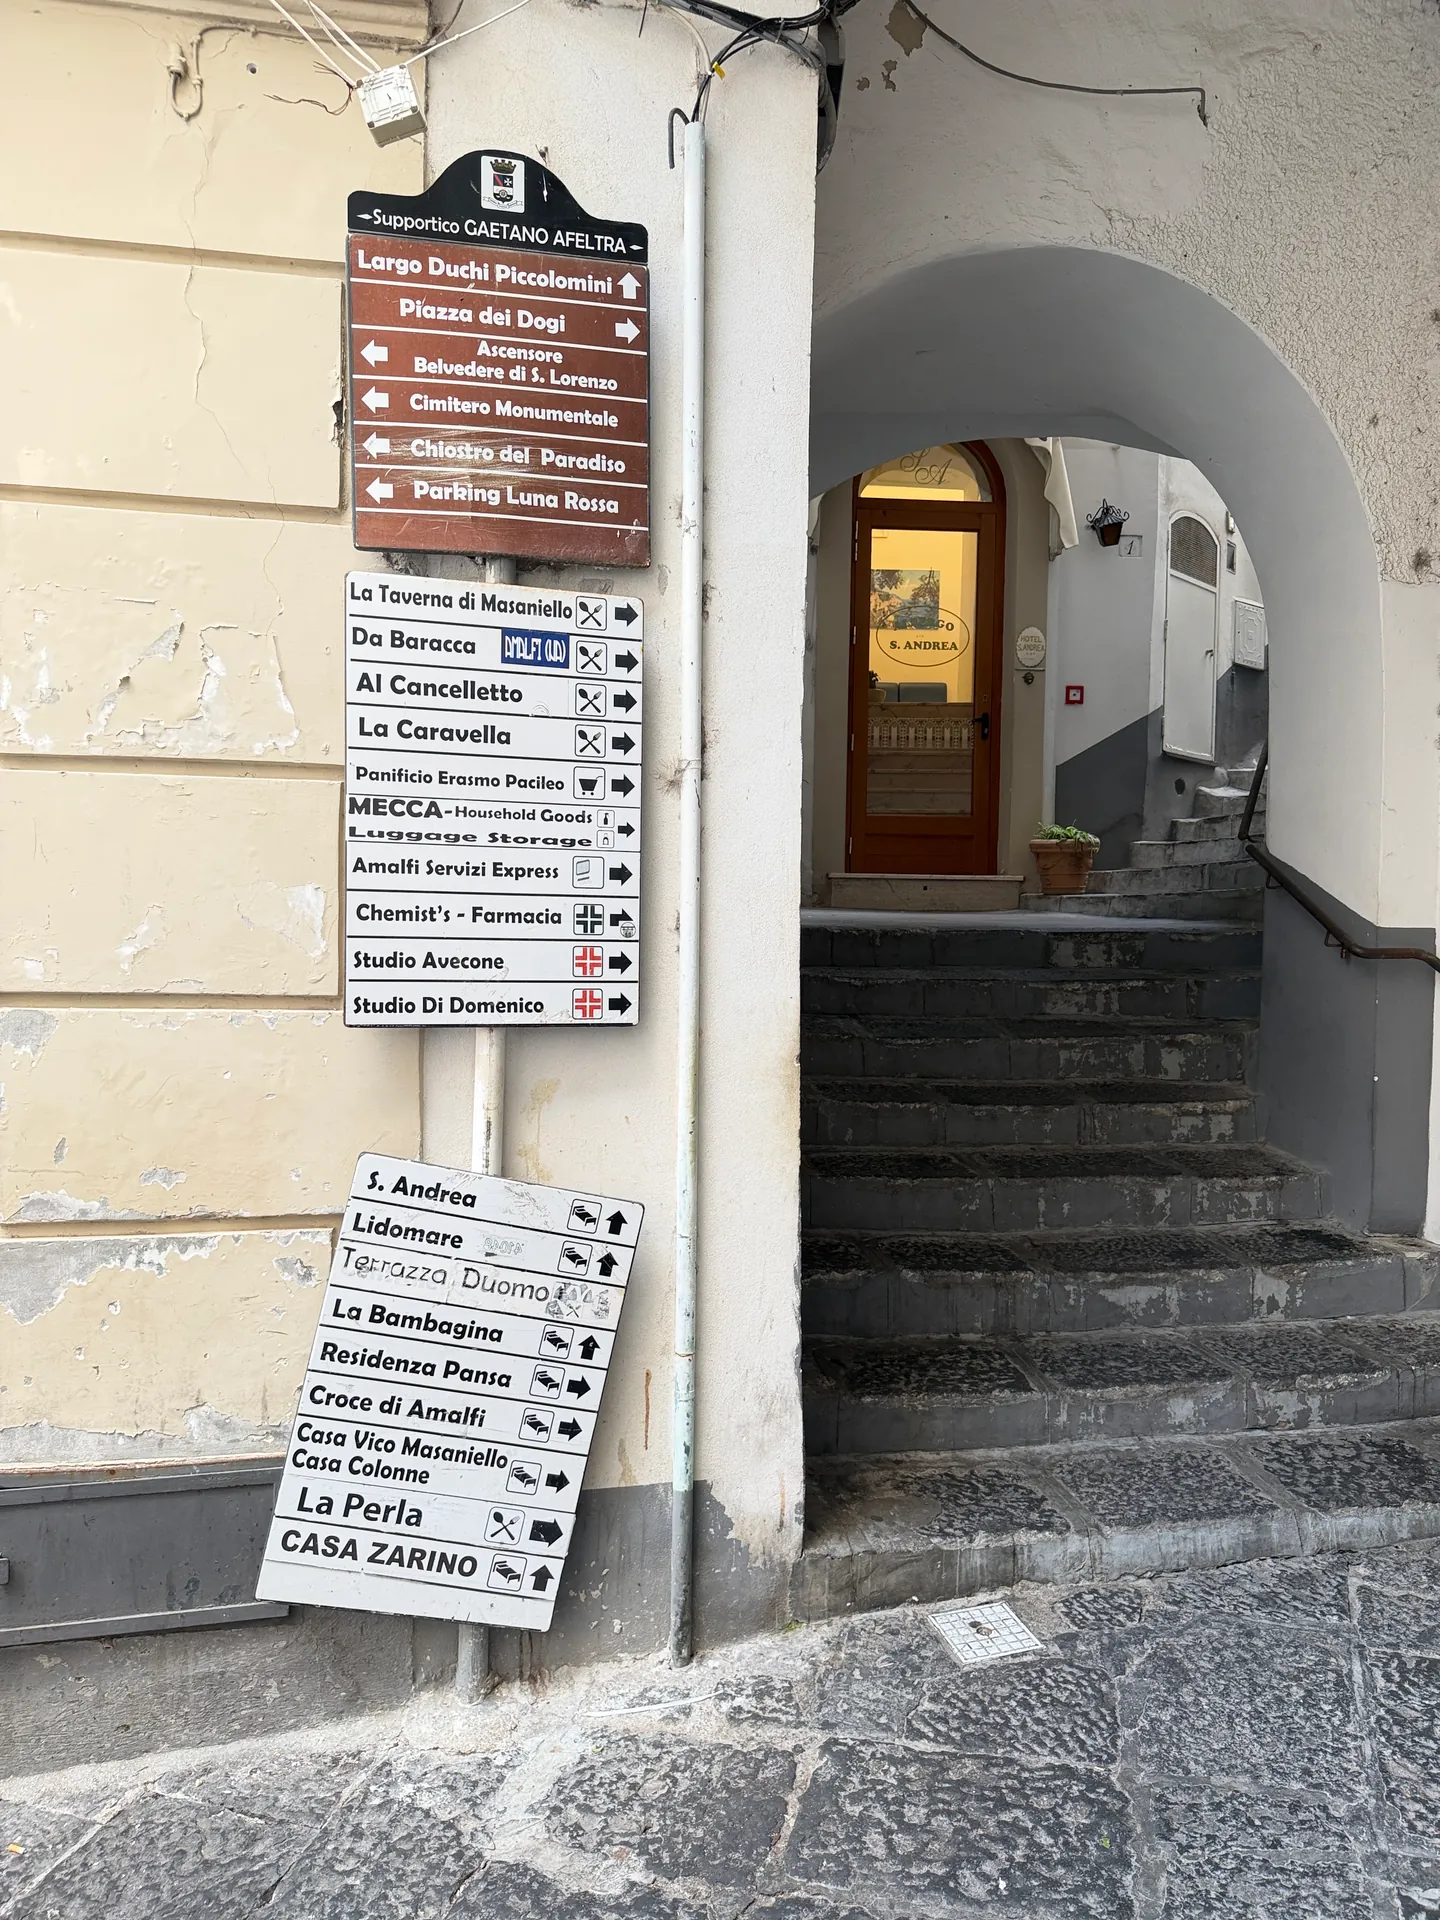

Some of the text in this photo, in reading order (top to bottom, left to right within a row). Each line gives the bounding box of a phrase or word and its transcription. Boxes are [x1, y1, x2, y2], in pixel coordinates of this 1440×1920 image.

[373, 209, 626, 253] Supportico GAETANO AFELTRA
[358, 250, 612, 294] Largo Duchi Piccolomini
[400, 298, 565, 335] Piazza dei Dogi
[477, 341, 563, 363] Ascensore
[414, 357, 618, 391] Belvedere di S. Lorenzo
[410, 393, 618, 428] Cimitero Monumentale
[410, 439, 626, 473] Chiostro del Paradiso
[414, 481, 618, 514] Parking Luna Rossa
[350, 582, 572, 619] La Taverna di Masaniello
[352, 627, 476, 654] Da Baracca
[505, 636, 542, 660] AMALFI
[889, 640, 958, 650] S. ANDREA
[356, 672, 523, 702] Al Cancelletto
[359, 717, 511, 745] La Caravella
[356, 766, 564, 790] Panificio Erasmo Pacileo
[541, 810, 592, 824] Goods
[349, 827, 592, 847] Luggage Storage
[352, 857, 558, 880] Amalfi Servizi Express
[356, 904, 450, 922] Chemist's
[472, 907, 562, 924] Farmacia
[353, 951, 504, 969] Studio Avecone
[353, 996, 544, 1014] Studio Di Domenico
[367, 1171, 477, 1208] S. Andrea
[353, 1213, 463, 1249] Lidomare
[342, 1246, 447, 1284] Terrazza
[462, 1267, 550, 1302] Duomo
[333, 1299, 503, 1343] La Bambagina
[320, 1342, 511, 1388] Residenza Pansa
[309, 1385, 486, 1428] Croce di Amalfi
[297, 1422, 508, 1469] Casa Vico Masaniello
[292, 1449, 430, 1485] Casa Colonne
[297, 1487, 423, 1527] La Perla
[281, 1529, 477, 1577] CASA ZARINO
